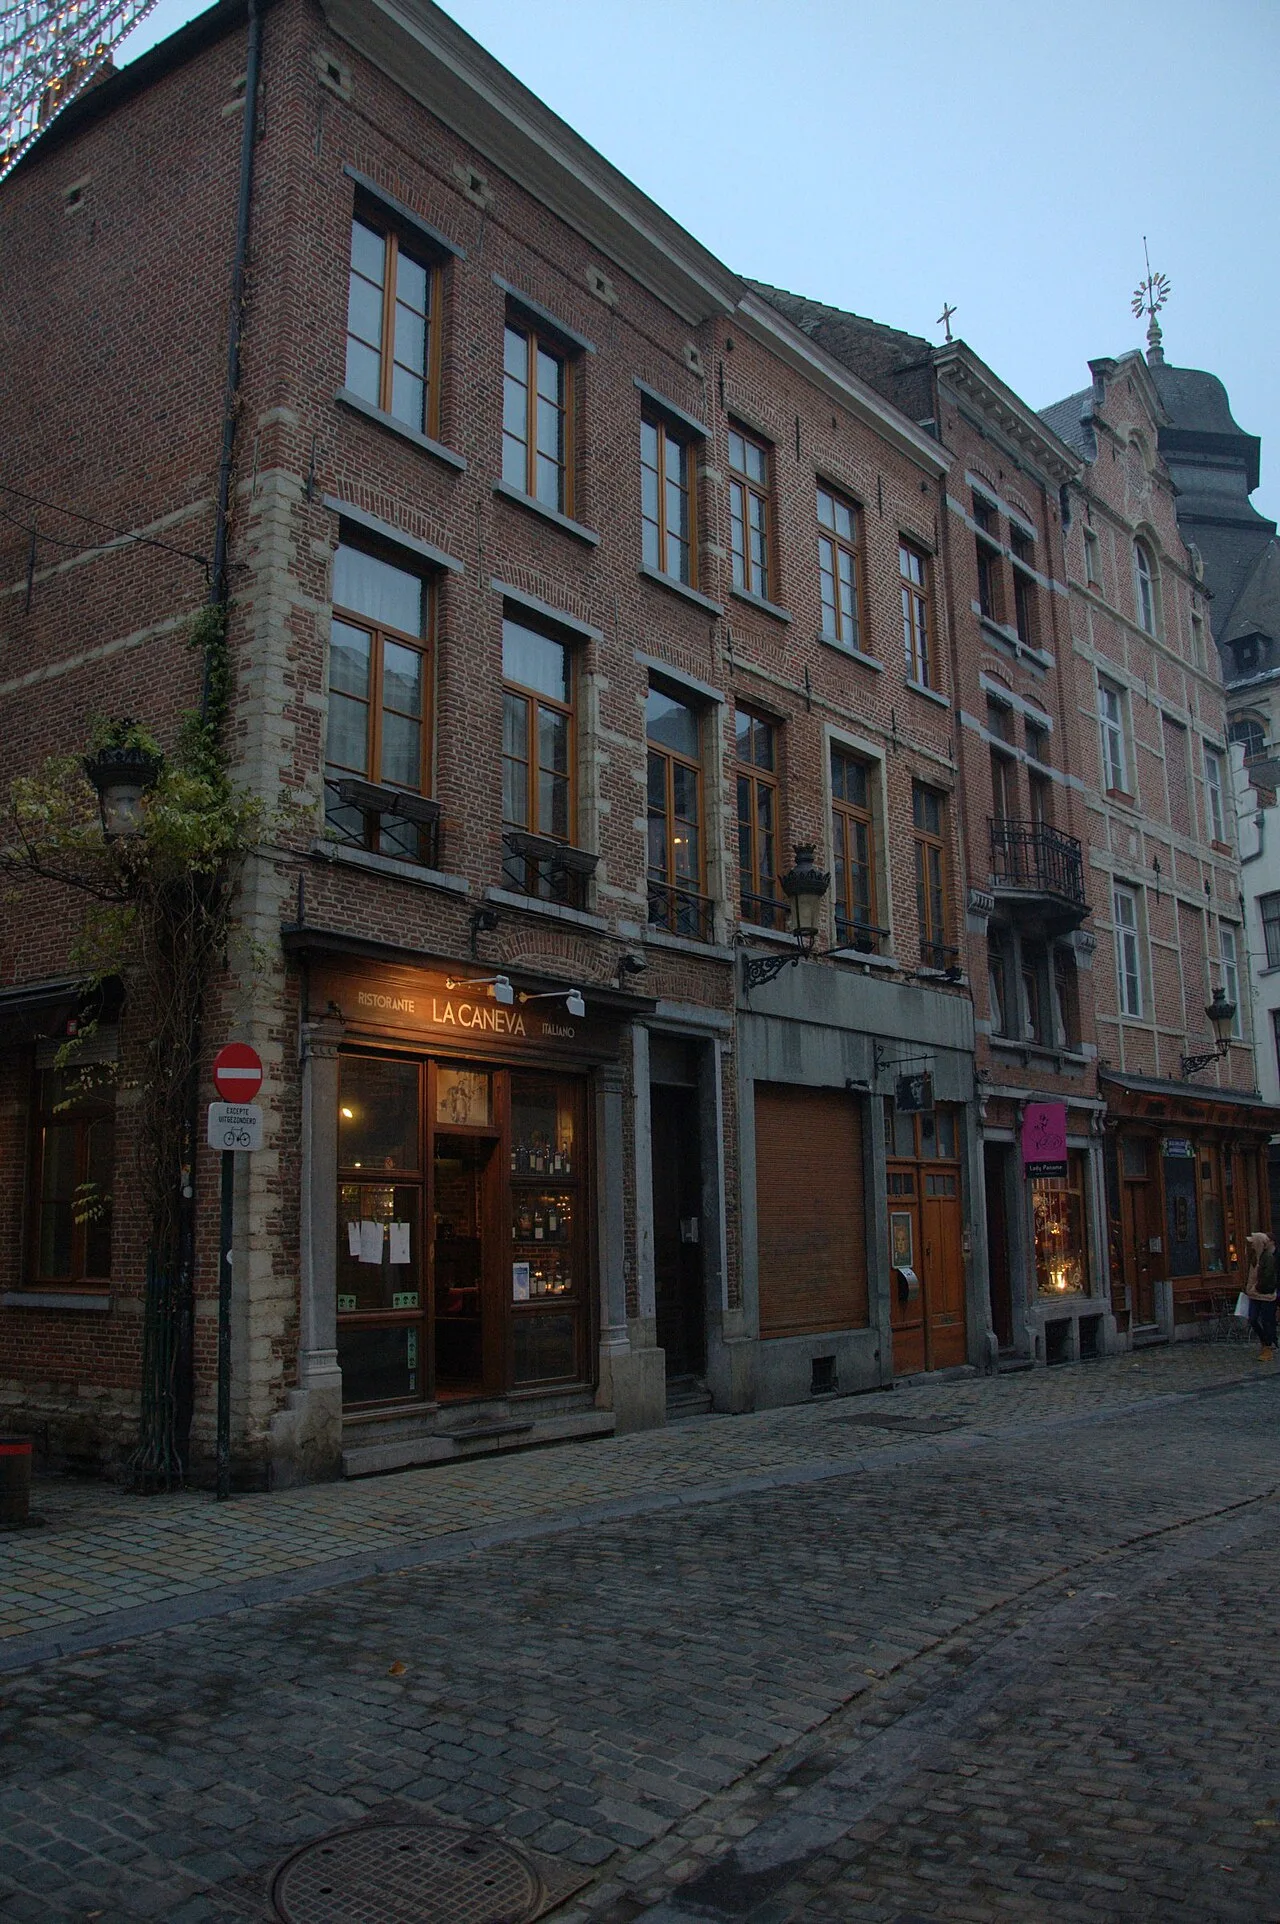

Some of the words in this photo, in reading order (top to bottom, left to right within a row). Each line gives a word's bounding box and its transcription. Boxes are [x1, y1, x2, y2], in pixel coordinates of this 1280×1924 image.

[358, 991, 415, 1013] RISTORANTE
[432, 998, 456, 1025] LA
[458, 1004, 526, 1037] CANEVA
[542, 1022, 575, 1038] ITALIANO
[226, 1107, 249, 1115] EXCEPTE
[218, 1116, 256, 1125] UITGEZONDERD
